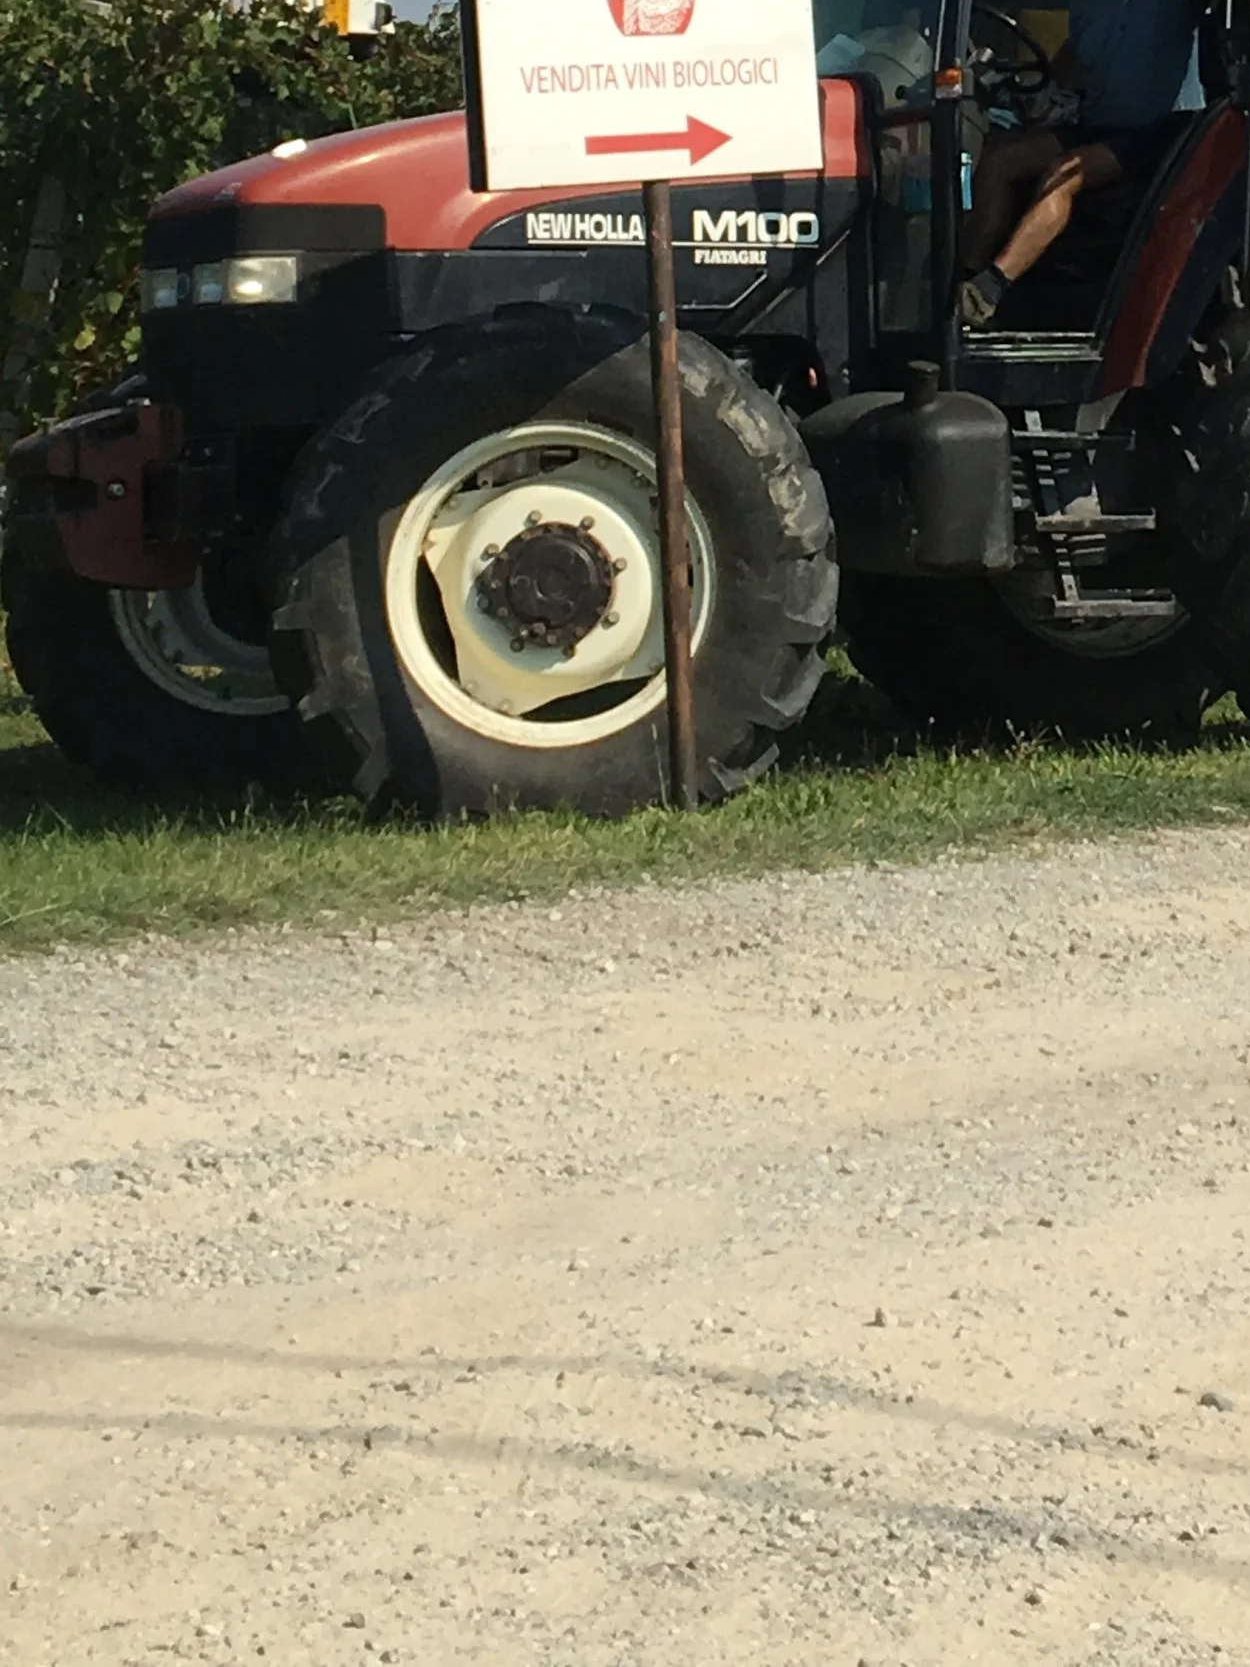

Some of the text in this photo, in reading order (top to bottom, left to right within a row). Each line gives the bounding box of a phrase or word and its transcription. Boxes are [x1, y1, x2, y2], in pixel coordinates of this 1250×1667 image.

[519, 57, 779, 94] VENDITA VINI BIOLOGICI
[526, 212, 646, 241] NEW HOLLA
[692, 209, 820, 244] M100
[694, 249, 767, 265] FIATAGRI
